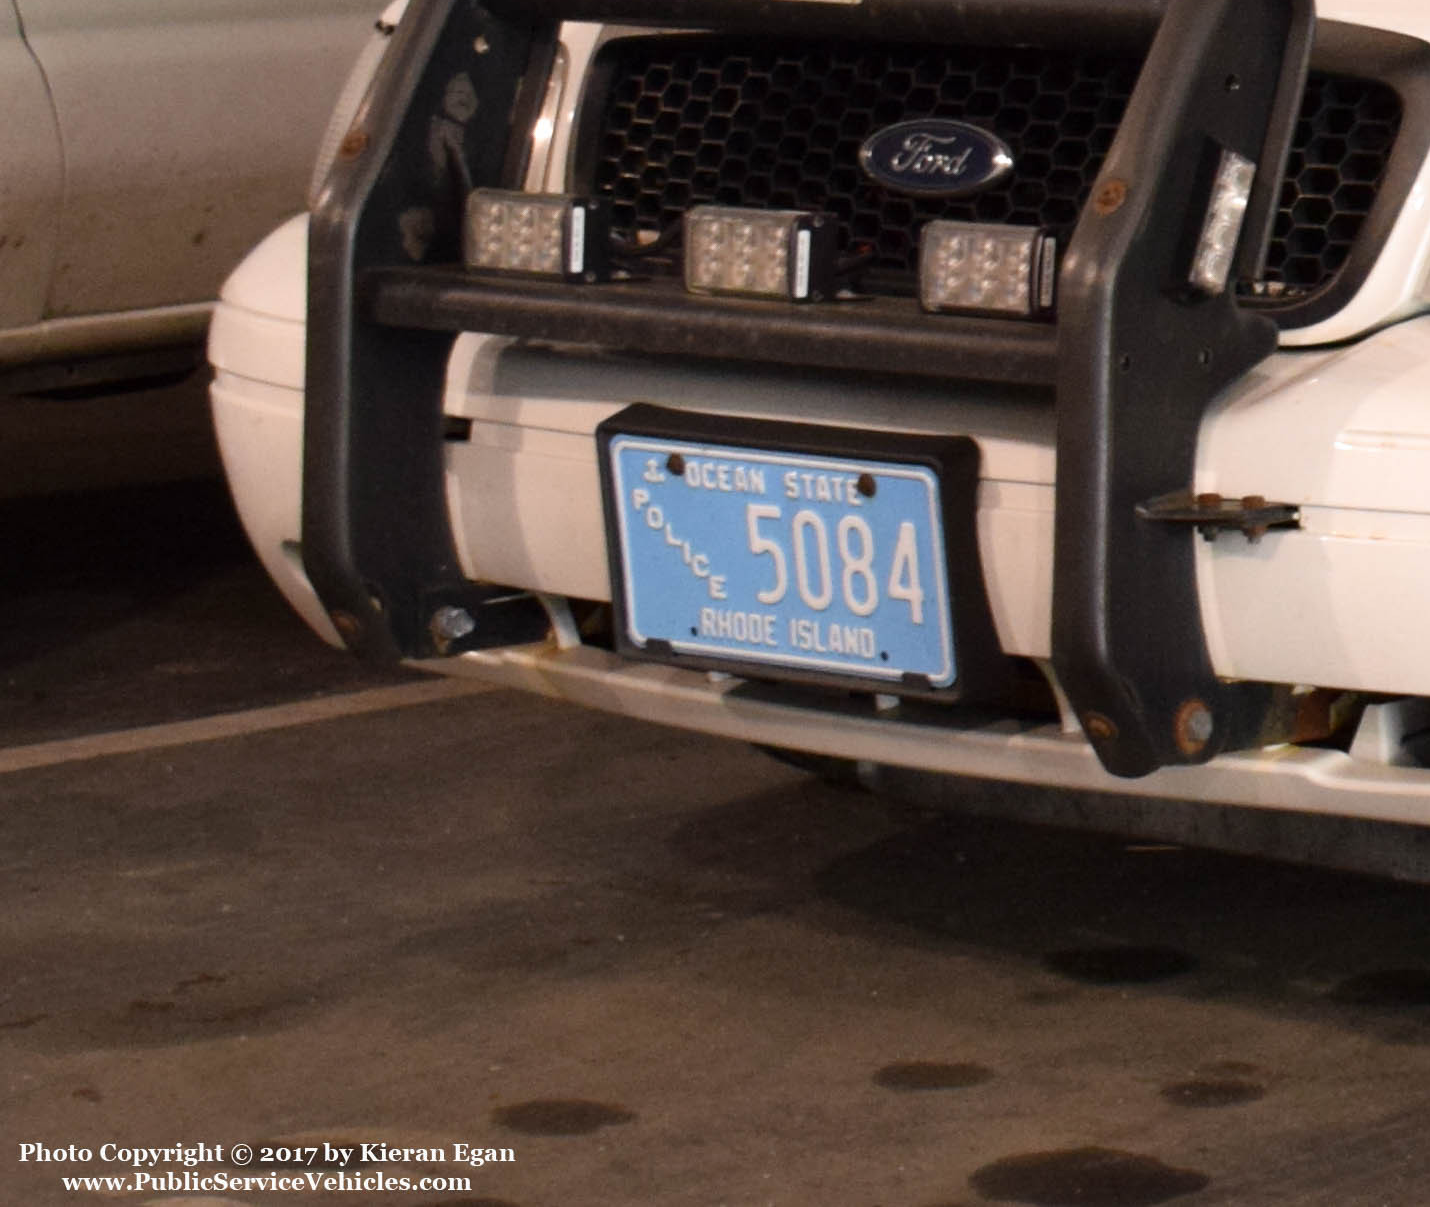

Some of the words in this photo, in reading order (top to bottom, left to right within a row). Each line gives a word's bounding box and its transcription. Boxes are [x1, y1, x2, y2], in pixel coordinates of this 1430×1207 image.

[892, 133, 973, 175] Ford
[684, 460, 766, 495] OCEAN
[784, 471, 863, 506] STATE
[631, 489, 727, 600] POLICE
[746, 502, 925, 625] 5084
[700, 607, 778, 647] RHODE
[790, 621, 876, 659] ISLAND
